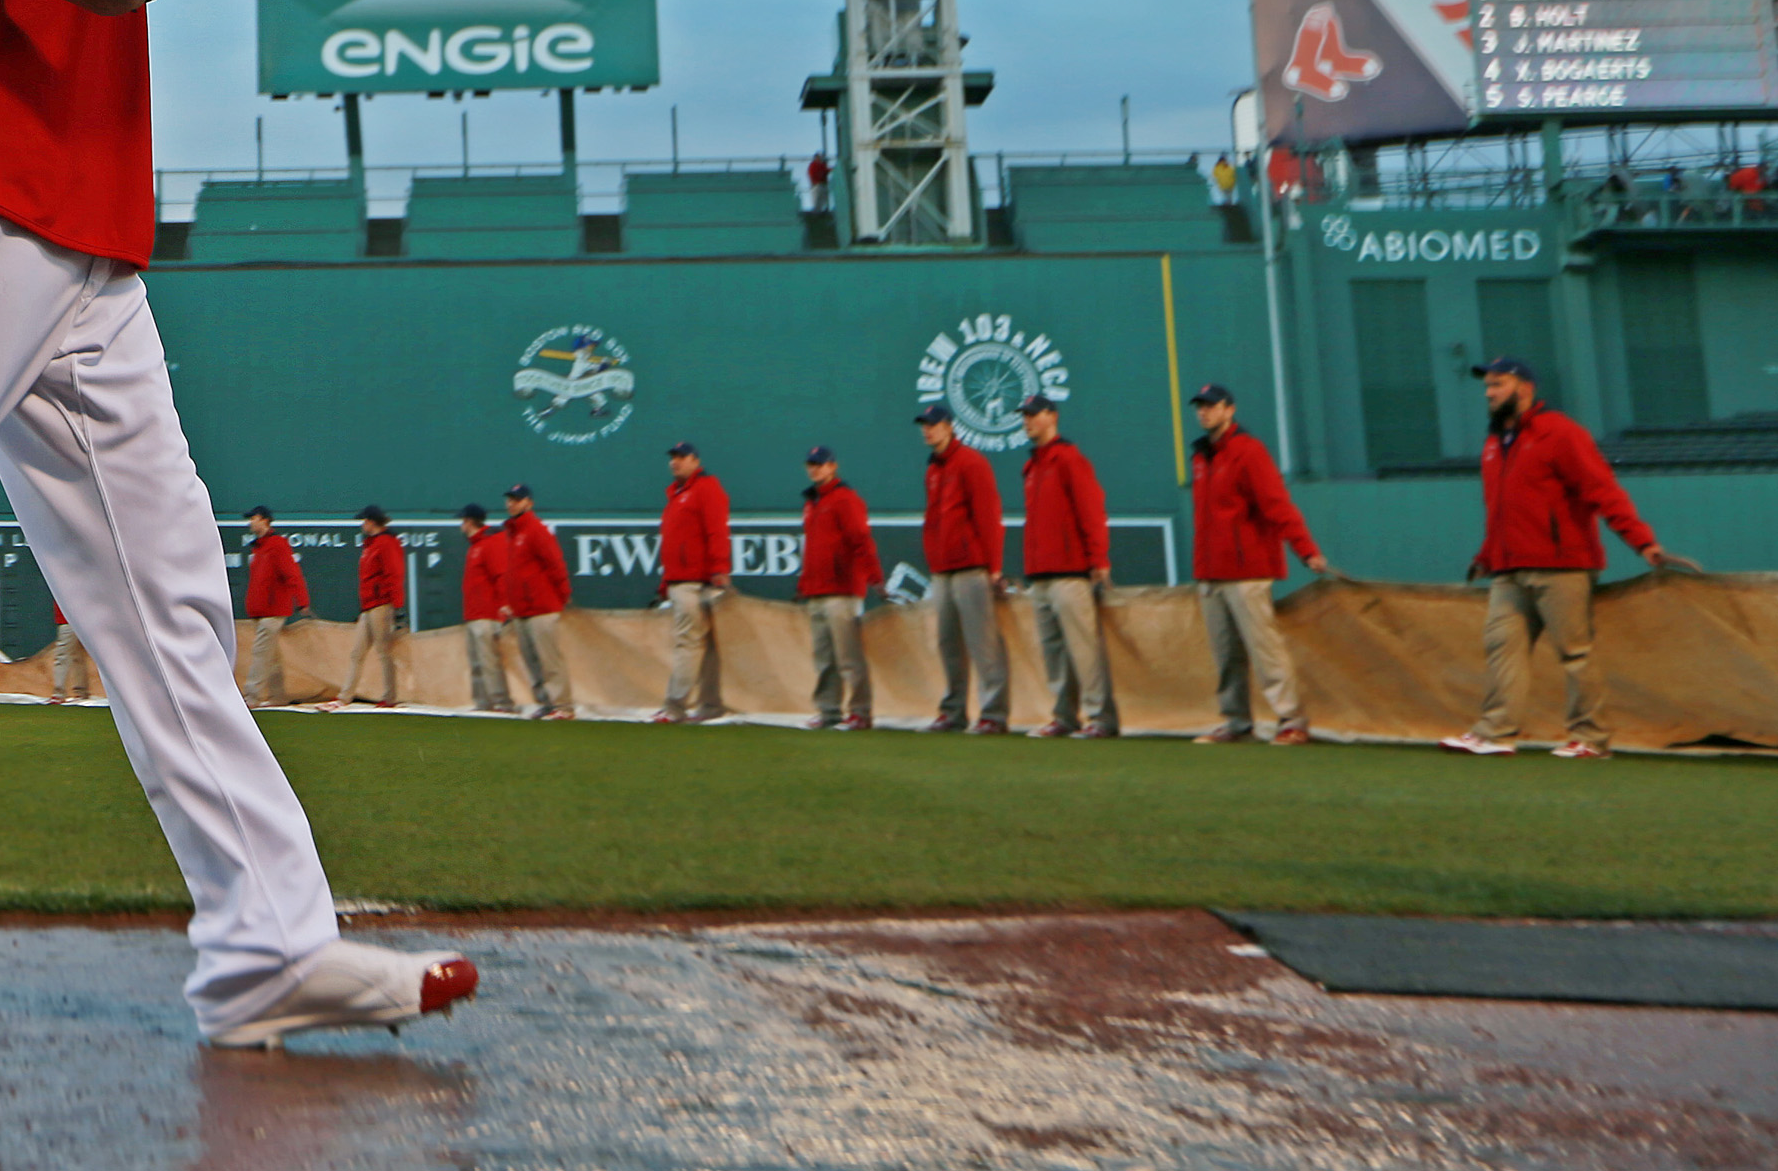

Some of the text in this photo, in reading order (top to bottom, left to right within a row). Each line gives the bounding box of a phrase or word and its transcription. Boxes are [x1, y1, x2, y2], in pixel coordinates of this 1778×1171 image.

[1479, 3, 1497, 27] 2
[1535, 2, 1590, 27] HOLT
[1481, 29, 1498, 53] 3
[1536, 28, 1641, 52] MARTINEZ
[1484, 58, 1502, 81] 4
[1541, 57, 1652, 81] BOGAERTS
[1485, 83, 1504, 107] 5
[1542, 82, 1628, 107] PEARCE
[1358, 229, 1541, 263] ABIOMED
[958, 313, 1012, 345] 103
[728, 534, 805, 576] EB
